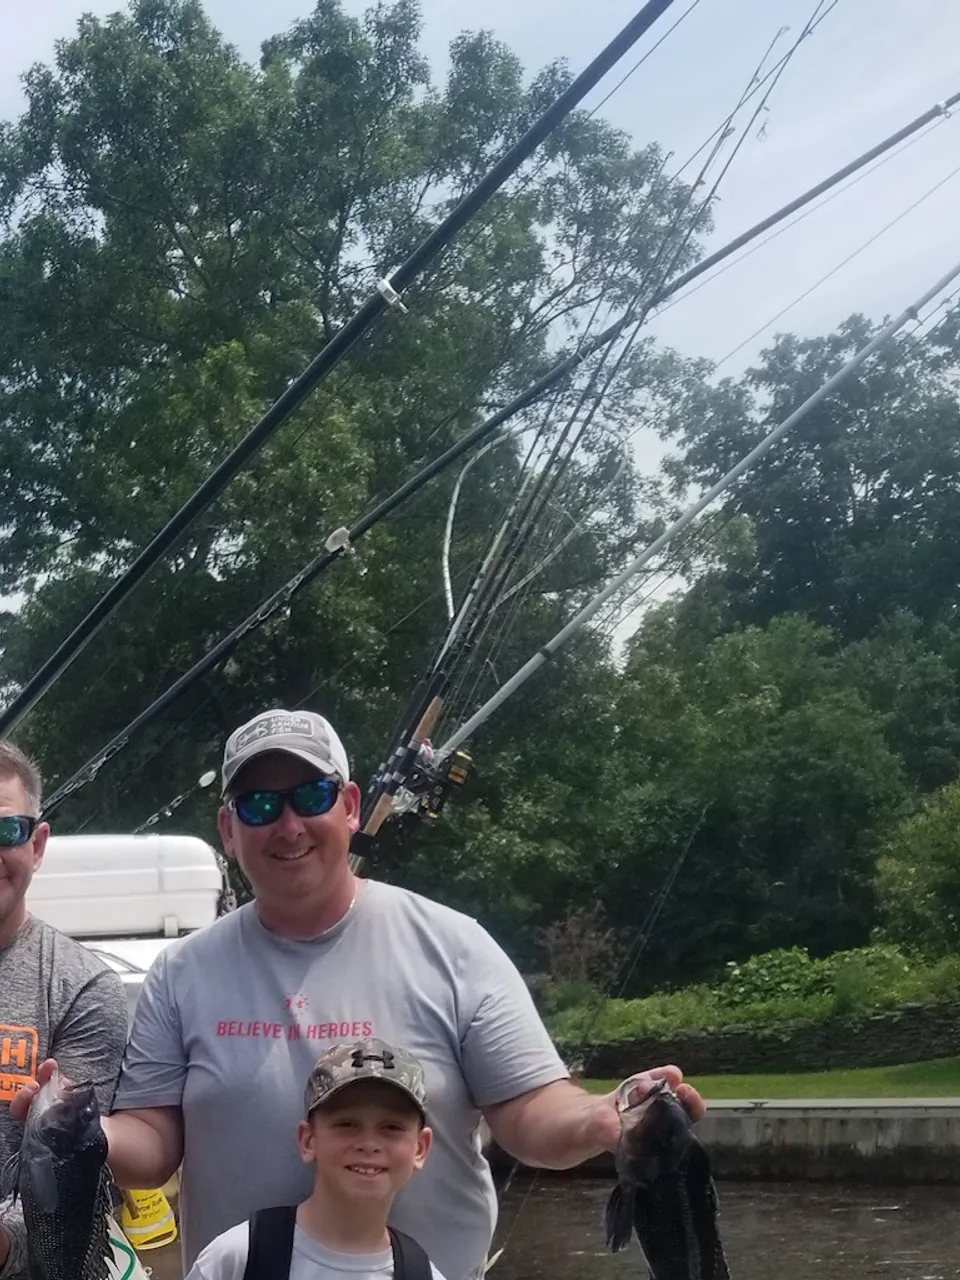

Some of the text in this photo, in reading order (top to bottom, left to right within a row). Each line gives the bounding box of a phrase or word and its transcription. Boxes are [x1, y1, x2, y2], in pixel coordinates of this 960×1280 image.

[216, 1020, 374, 1041] BELIEVE IN HEROES
